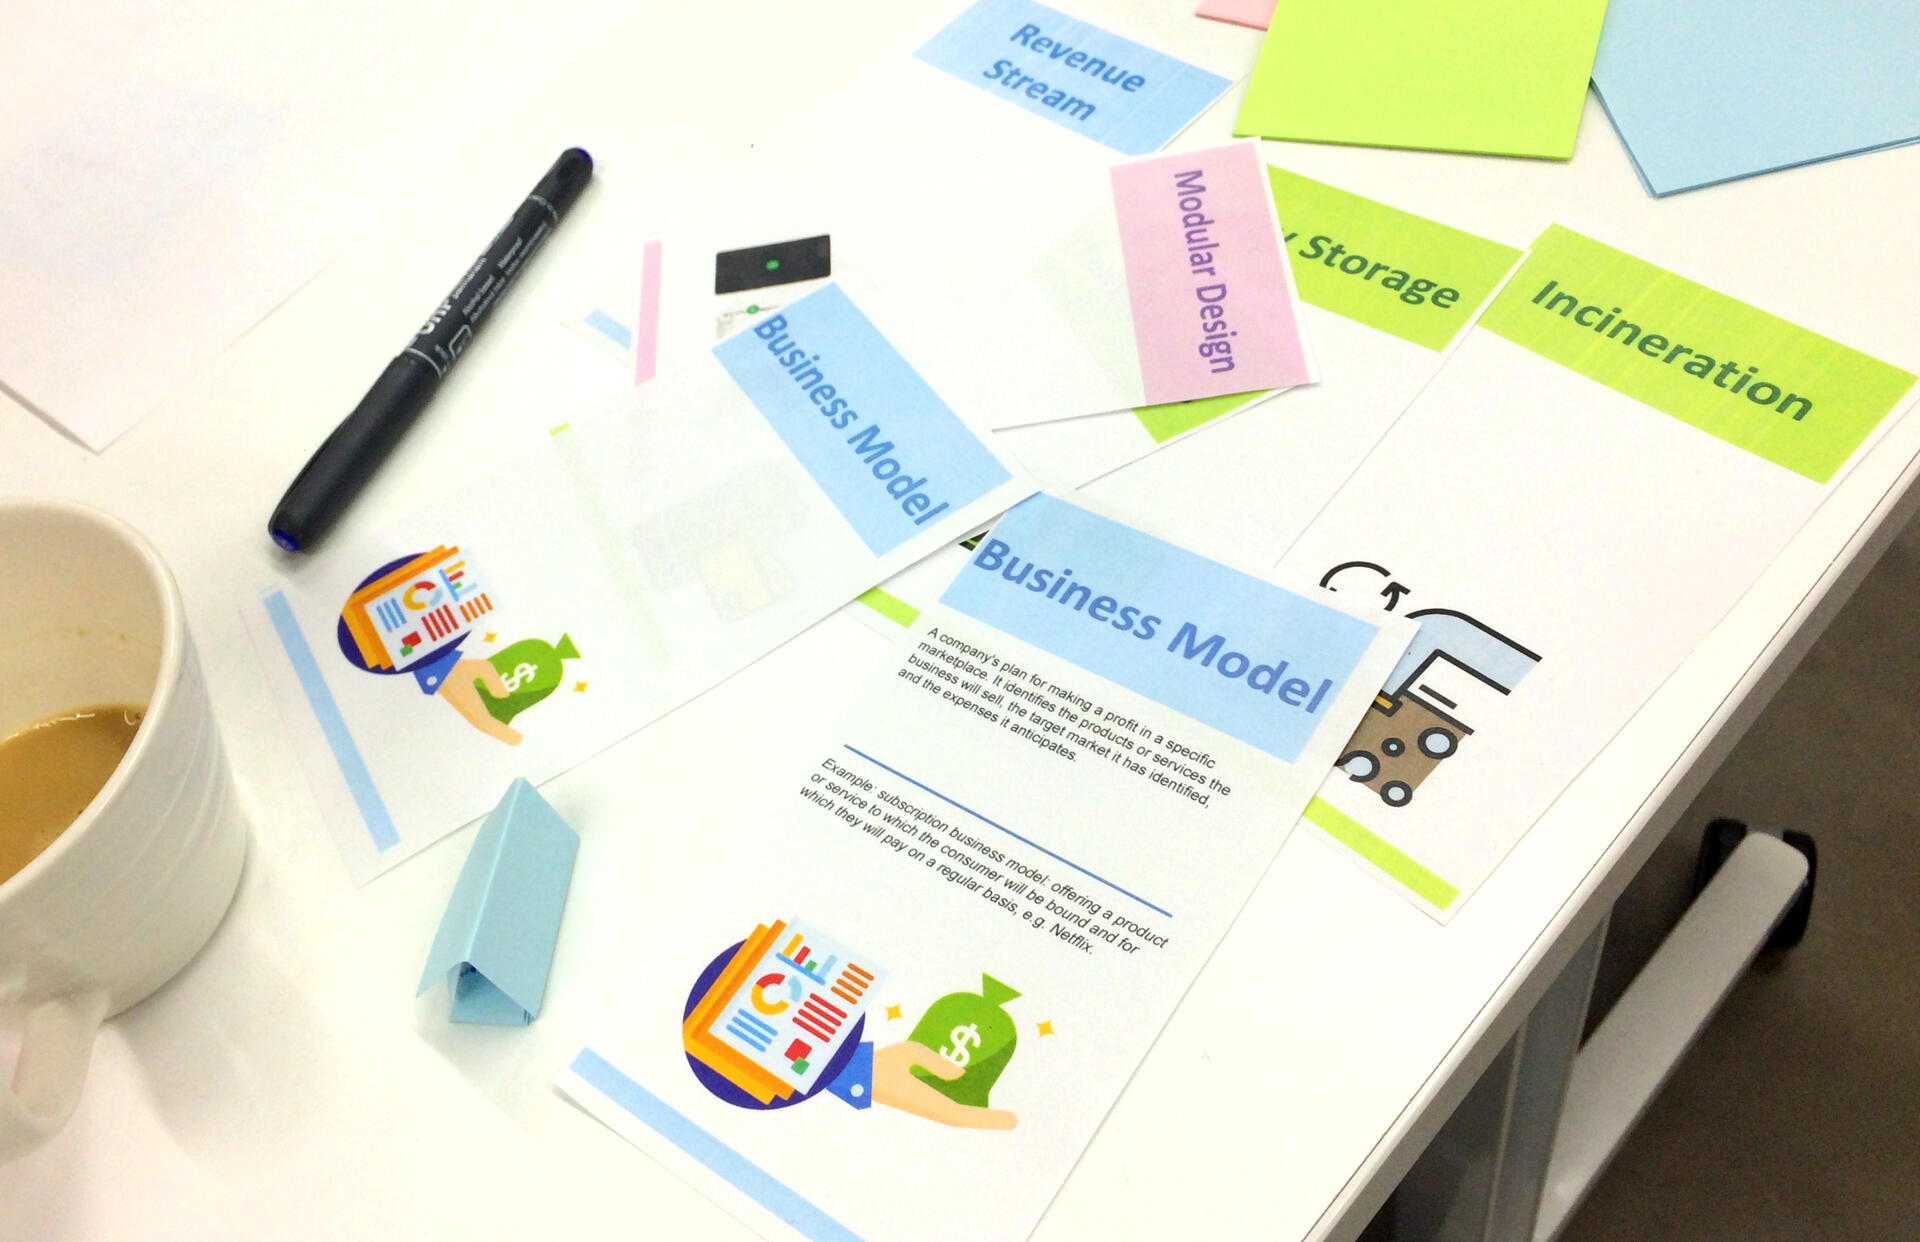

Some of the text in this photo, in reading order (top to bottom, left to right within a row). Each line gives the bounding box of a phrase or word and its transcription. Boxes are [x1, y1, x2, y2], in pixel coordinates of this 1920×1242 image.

[983, 60, 1096, 121] Stream
[1010, 23, 1146, 93] Revenue
[1174, 169, 1236, 374] Modular Design
[1299, 235, 1461, 309] Storage
[754, 314, 950, 525] Business Model
[1531, 280, 1813, 421] Incineration
[927, 627, 1216, 769] A company's plan for making a profit in a specific
[973, 538, 1334, 714] Business Model
[897, 668, 1076, 762] and the expenses it anticipates.
[907, 653, 1210, 809] business will sell, the target market it has identified,
[918, 642, 1231, 796] marketplace. It identifies the products or services the
[799, 786, 1093, 955] which they will pay on a regular basis, e.g. Netflix.
[810, 773, 1141, 954] or service to which the consumer will be bound and for
[821, 758, 1169, 949] Example: subscription business model: offering a product
